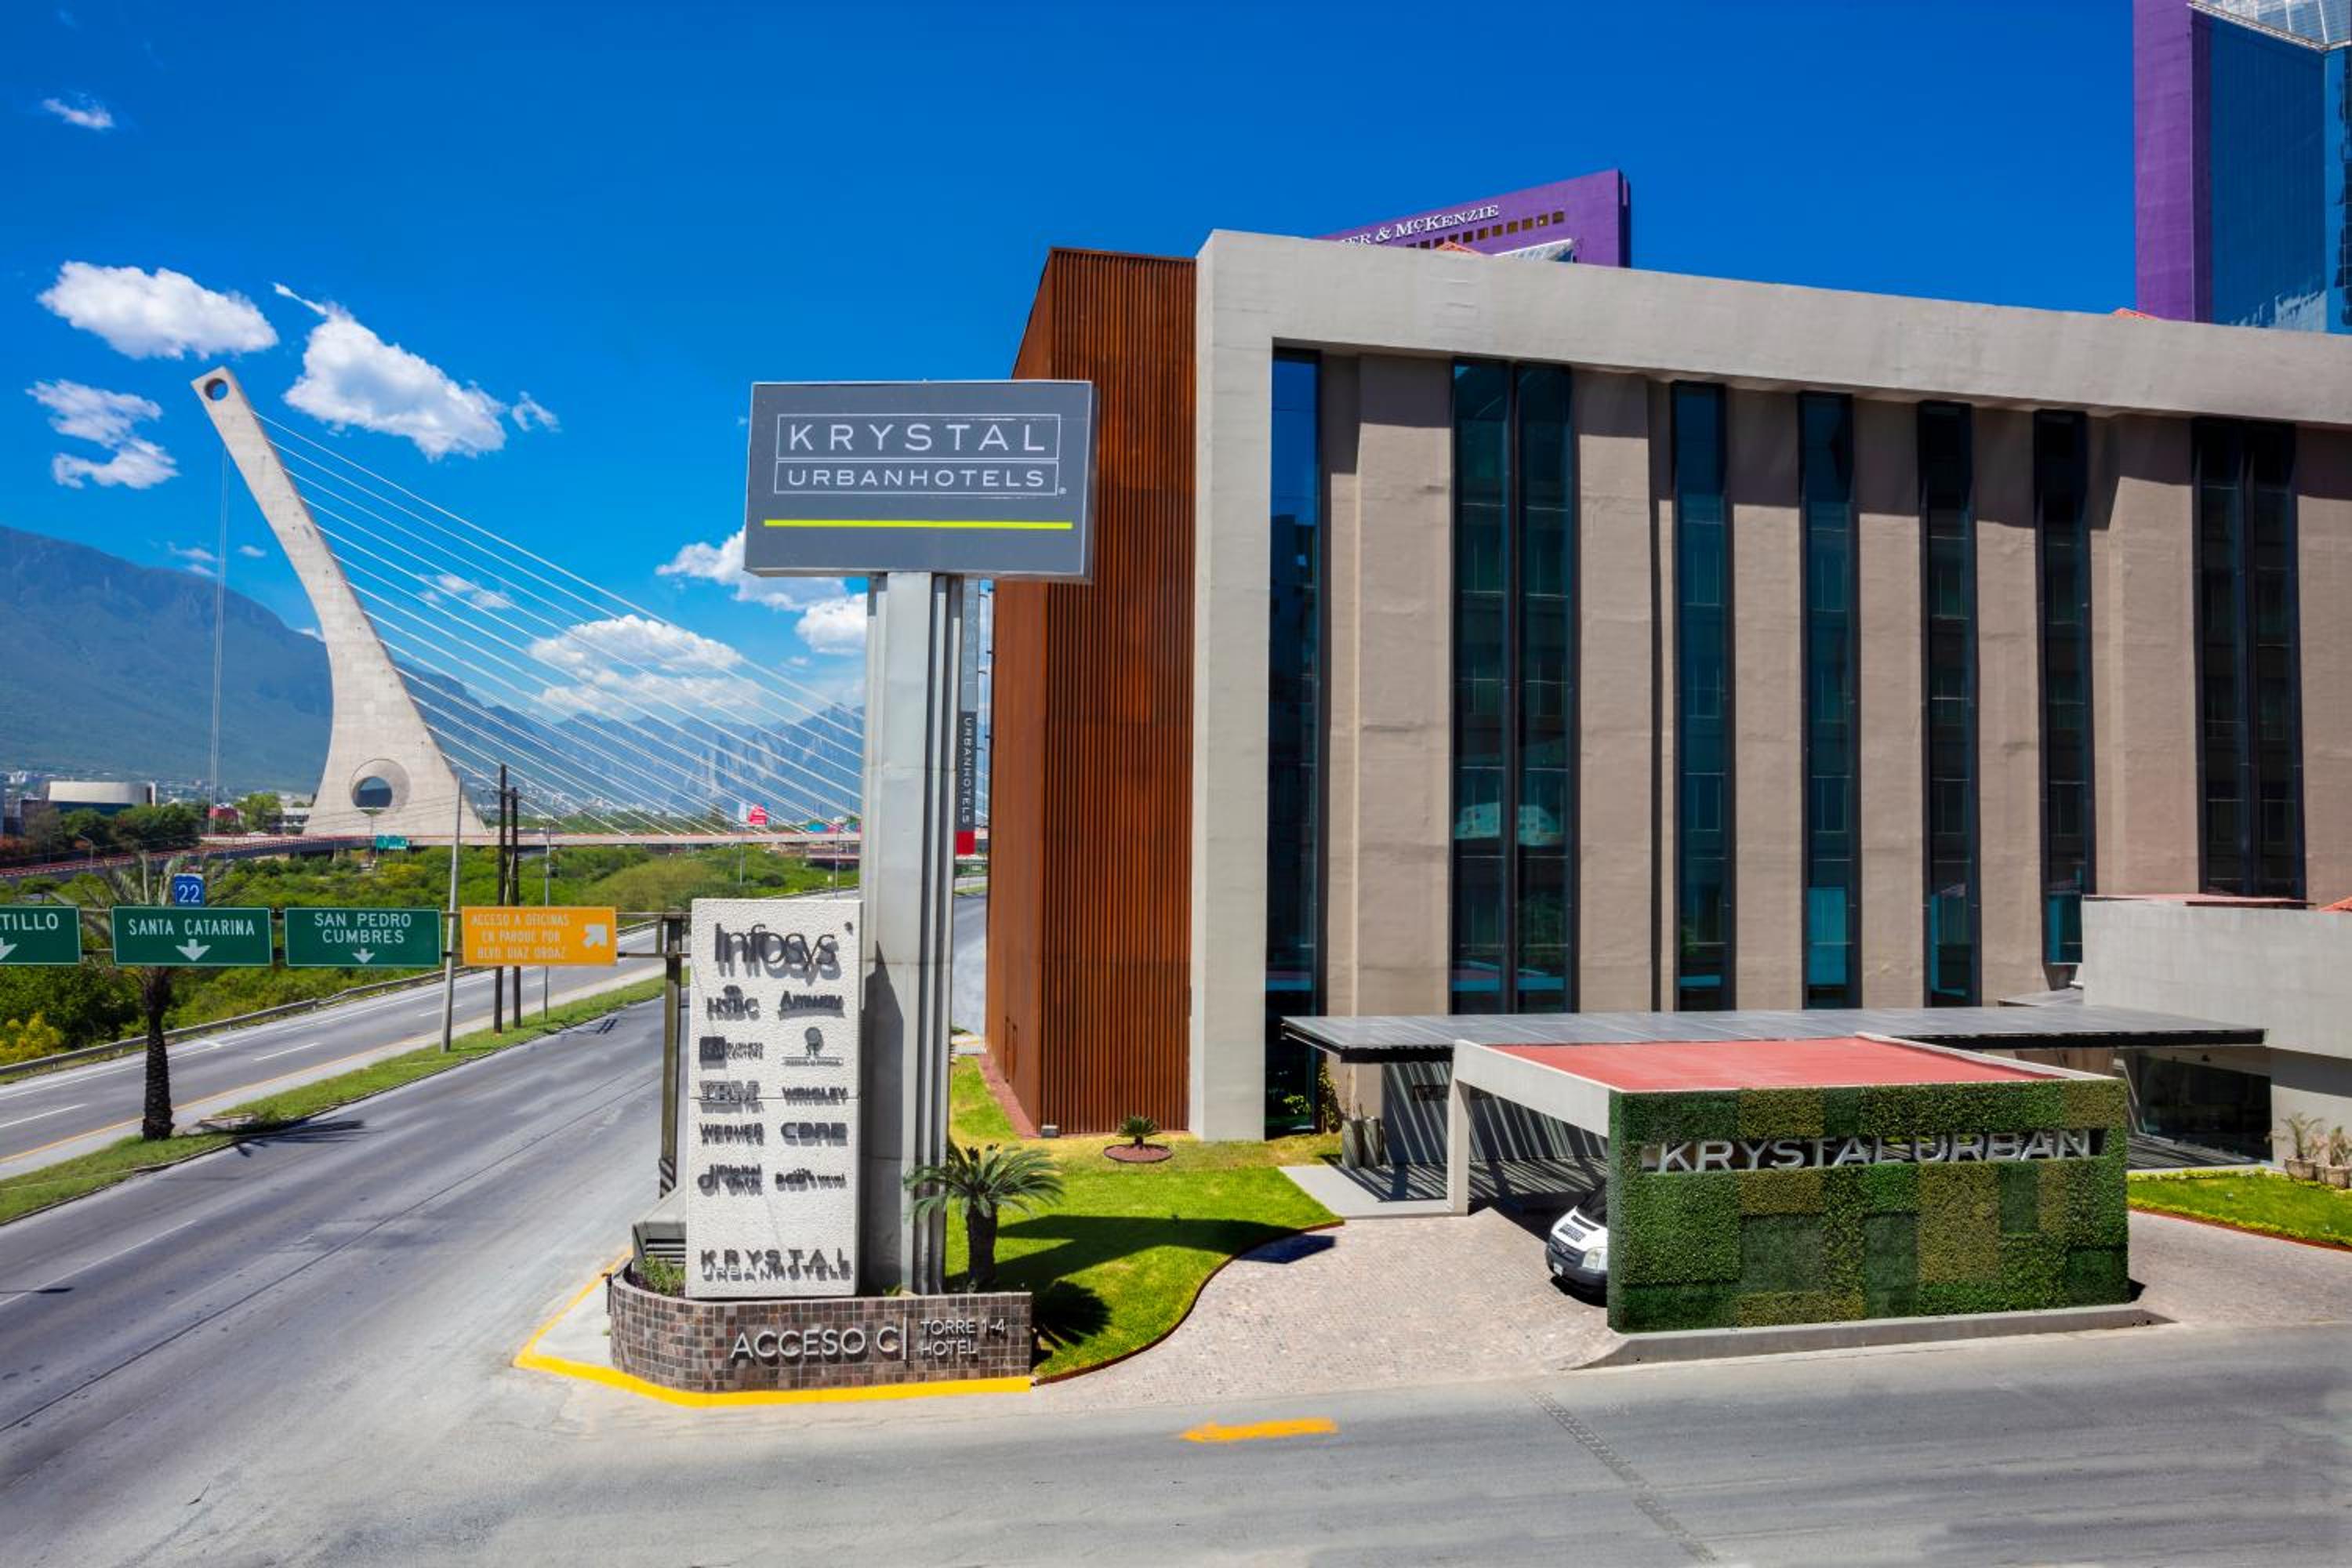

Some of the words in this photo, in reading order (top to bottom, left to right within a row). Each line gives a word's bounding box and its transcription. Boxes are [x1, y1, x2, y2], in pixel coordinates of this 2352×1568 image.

[1376, 227, 1392, 243] &
[789, 423, 1045, 452] KRYSTAL
[788, 469, 1044, 487] URBANHOTELS
[962, 717, 973, 823] URBANHOTELS
[178, 884, 201, 903] 22
[0, 913, 59, 931] TILLO
[128, 918, 175, 936] SANTA
[184, 918, 256, 936] CATARINA
[314, 913, 347, 927] SAN
[357, 913, 412, 927] PEDRO
[471, 913, 510, 927] ACCESO
[322, 929, 405, 944] CUMBRES
[714, 923, 837, 973] Infosys
[1657, 1136, 1904, 1174] KRYSTAL
[1915, 1129, 2091, 1164] URBAN
[701, 1248, 850, 1269] KRYSTAL
[920, 1319, 976, 1335] TORRE
[982, 1318, 1006, 1334] 1-4
[730, 1327, 866, 1359] ACCESO
[876, 1326, 898, 1353] C
[920, 1339, 977, 1356] HOTEL
